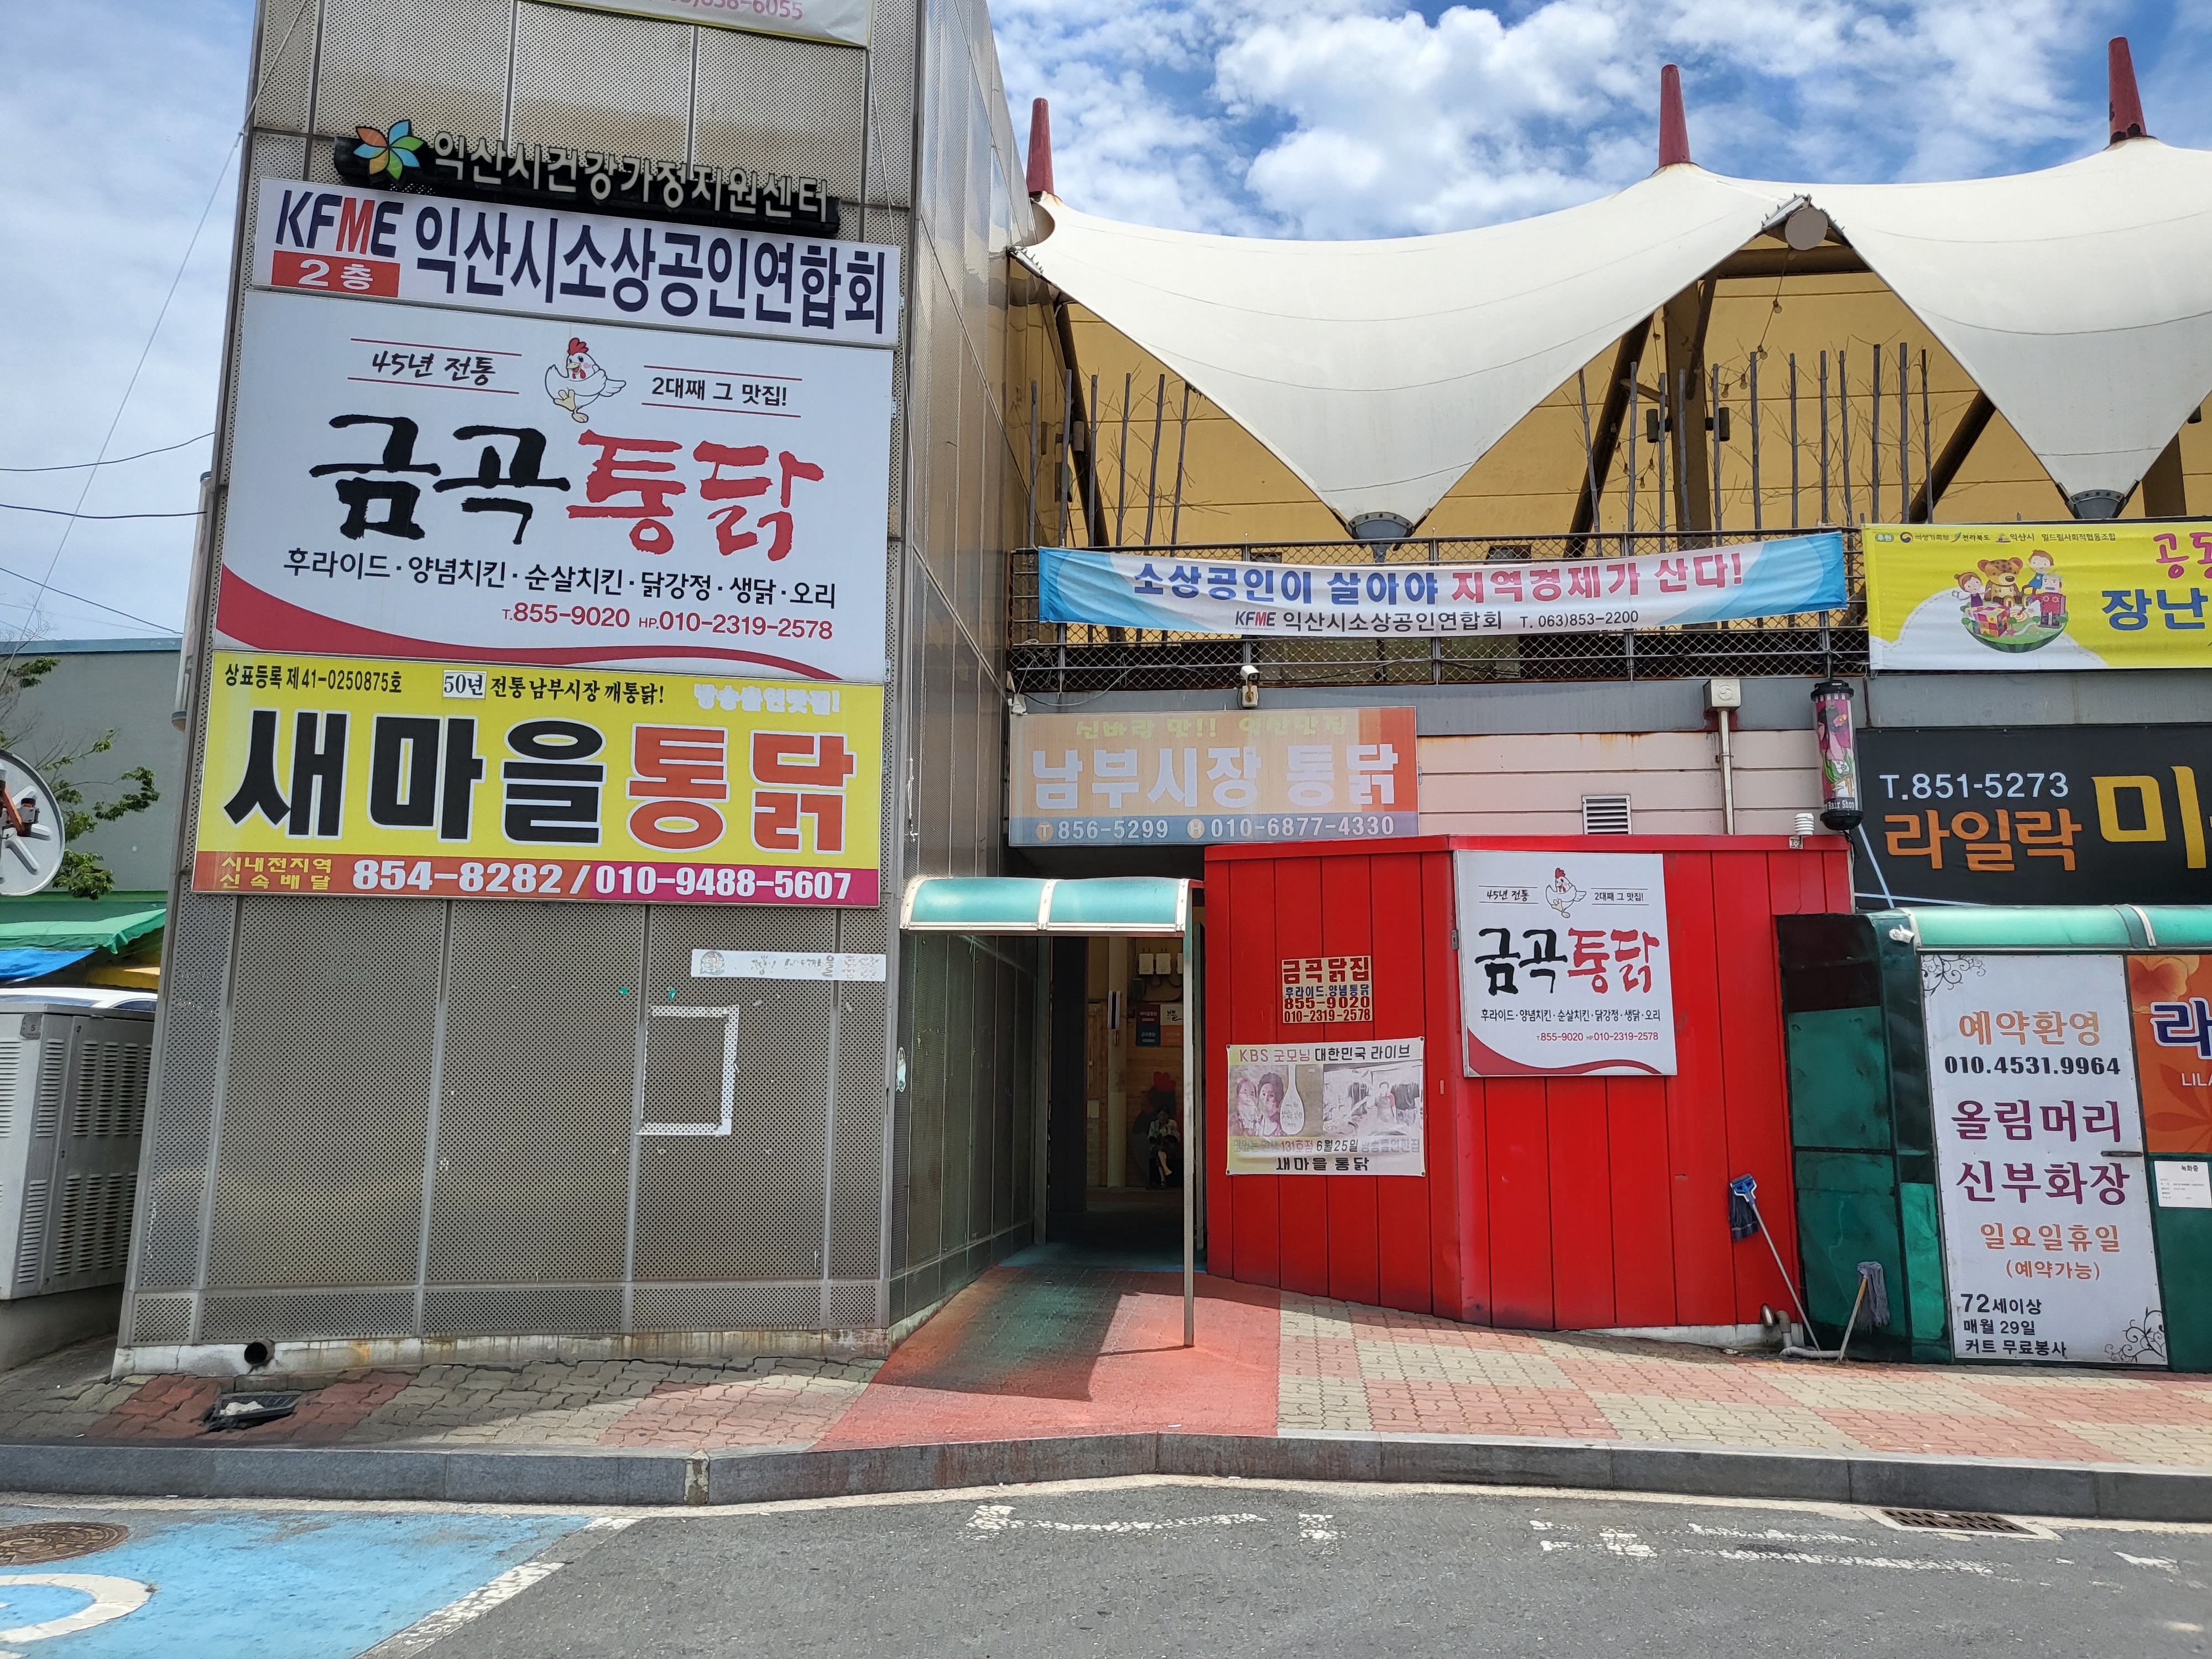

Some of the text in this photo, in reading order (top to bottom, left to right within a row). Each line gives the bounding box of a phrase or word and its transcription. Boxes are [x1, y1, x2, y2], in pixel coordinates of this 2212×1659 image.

[432, 129, 830, 224] 익산시건강가정지원센터
[275, 188, 886, 336] KFME 익산시소상공인연합회
[371, 350, 789, 409] 45년 전통 2대째 그 맛집!
[2010, 533, 2035, 542] 익산시
[1133, 552, 1744, 606] 소상공인이 살아야 지역경제가 산다!
[1234, 611, 1277, 627] KFME
[1282, 610, 1502, 633] 익산시소상공인연합회
[224, 662, 284, 690] 상표등록
[444, 674, 484, 697] 50년
[490, 676, 527, 698] 전통
[529, 678, 601, 702] 남부시장
[603, 681, 665, 706] 깨통닭!
[1031, 743, 1400, 811] 남부시장 통닭
[1880, 771, 2069, 800] T.851-5273
[1842, 799, 1855, 811] Shop
[1884, 765, 2212, 872] 라일락 미
[1057, 818, 1170, 842] 856-5299
[1209, 815, 1395, 839] 010-6877-4330
[221, 857, 333, 874] 시내전지역
[1486, 889, 1645, 902] 45년 전통 2대째 그 맛집!
[1283, 957, 1370, 985] 금곡닭집
[1284, 996, 1370, 1010] 855-9020
[1284, 1008, 1371, 1023] 010-2319-2578
[1958, 1009, 2101, 1046] 예약환영
[1239, 1048, 1269, 1063] KBS
[1314, 1046, 1366, 1062] 대한민국
[1370, 1044, 1411, 1060] 라이브
[1943, 1055, 2121, 1076] 010.4531.9964
[1950, 1099, 2122, 1143] 올림머리
[1955, 1160, 2131, 1206] 신부화장
[1979, 1222, 2121, 1253] 일요일휴일
[2005, 1258, 2101, 1281] (예약가능)
[1959, 1292, 2043, 1316] 72세이상
[1963, 1318, 2036, 1337] 매월 29일
[1964, 1338, 2067, 1358] 커트 무료봉사
